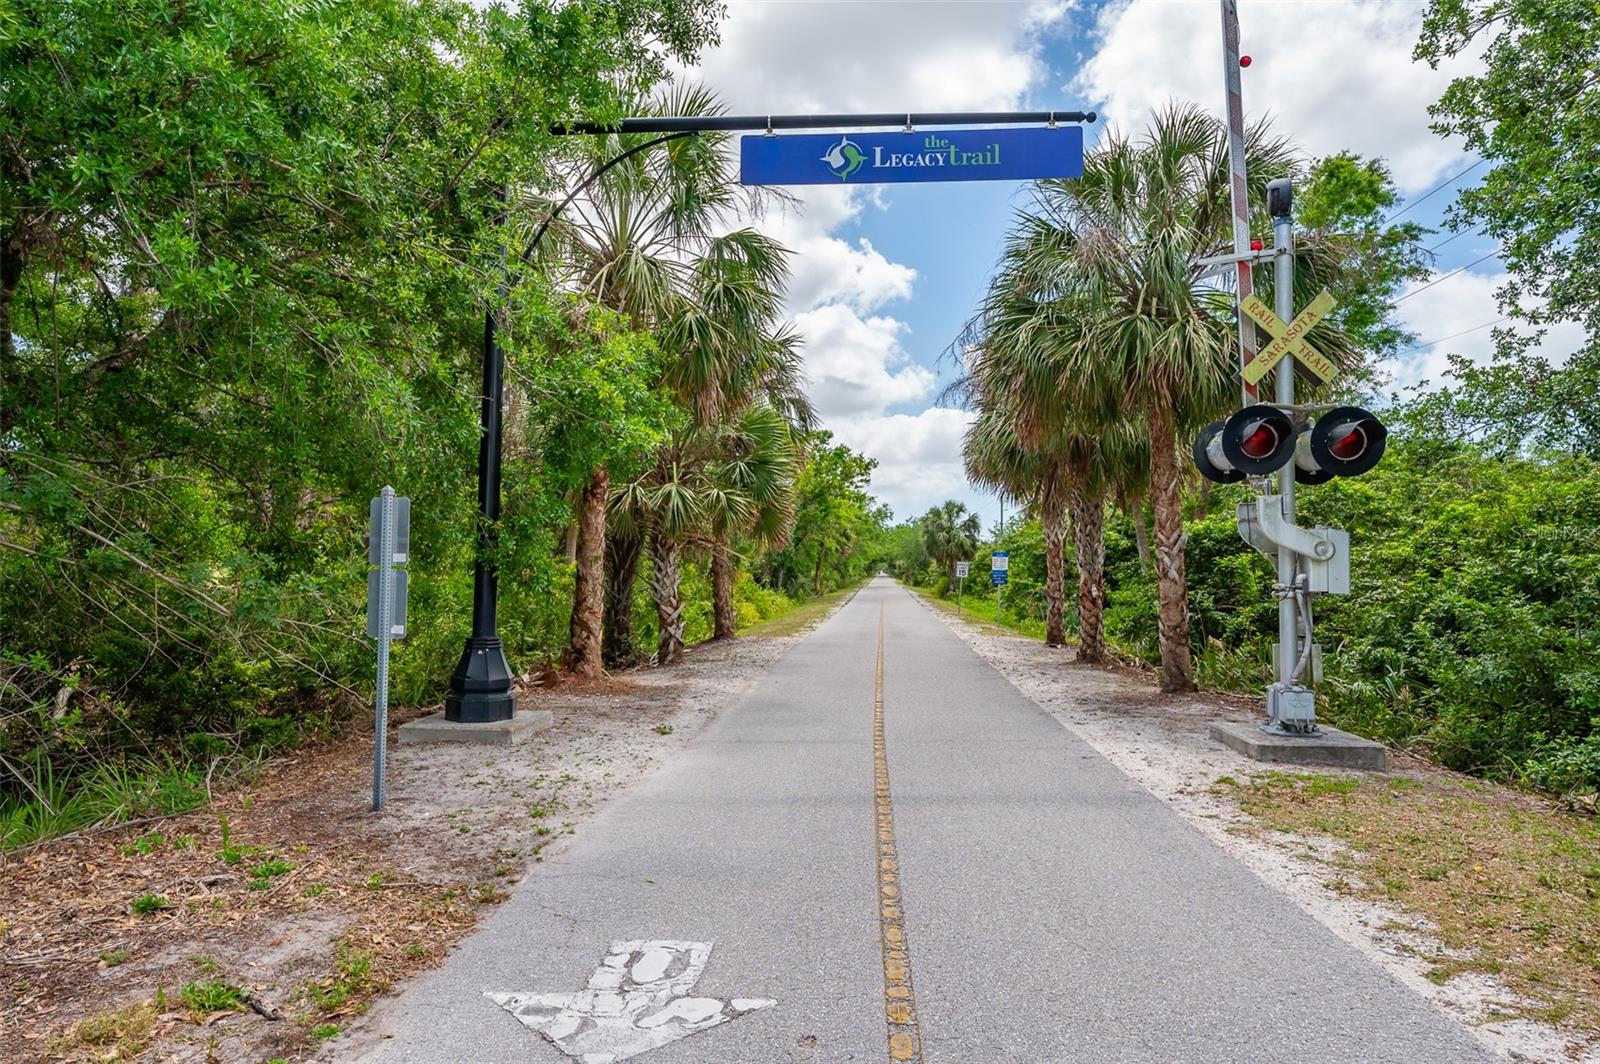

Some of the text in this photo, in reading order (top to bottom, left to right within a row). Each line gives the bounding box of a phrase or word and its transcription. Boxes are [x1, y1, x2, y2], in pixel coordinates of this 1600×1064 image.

[924, 135, 949, 148] the
[873, 144, 1001, 168] LEGACY trail
[1248, 302, 1274, 328] RAIL
[1259, 310, 1317, 366] SARASOTA
[1298, 343, 1330, 377] TRAIL
[959, 569, 967, 577] 15
